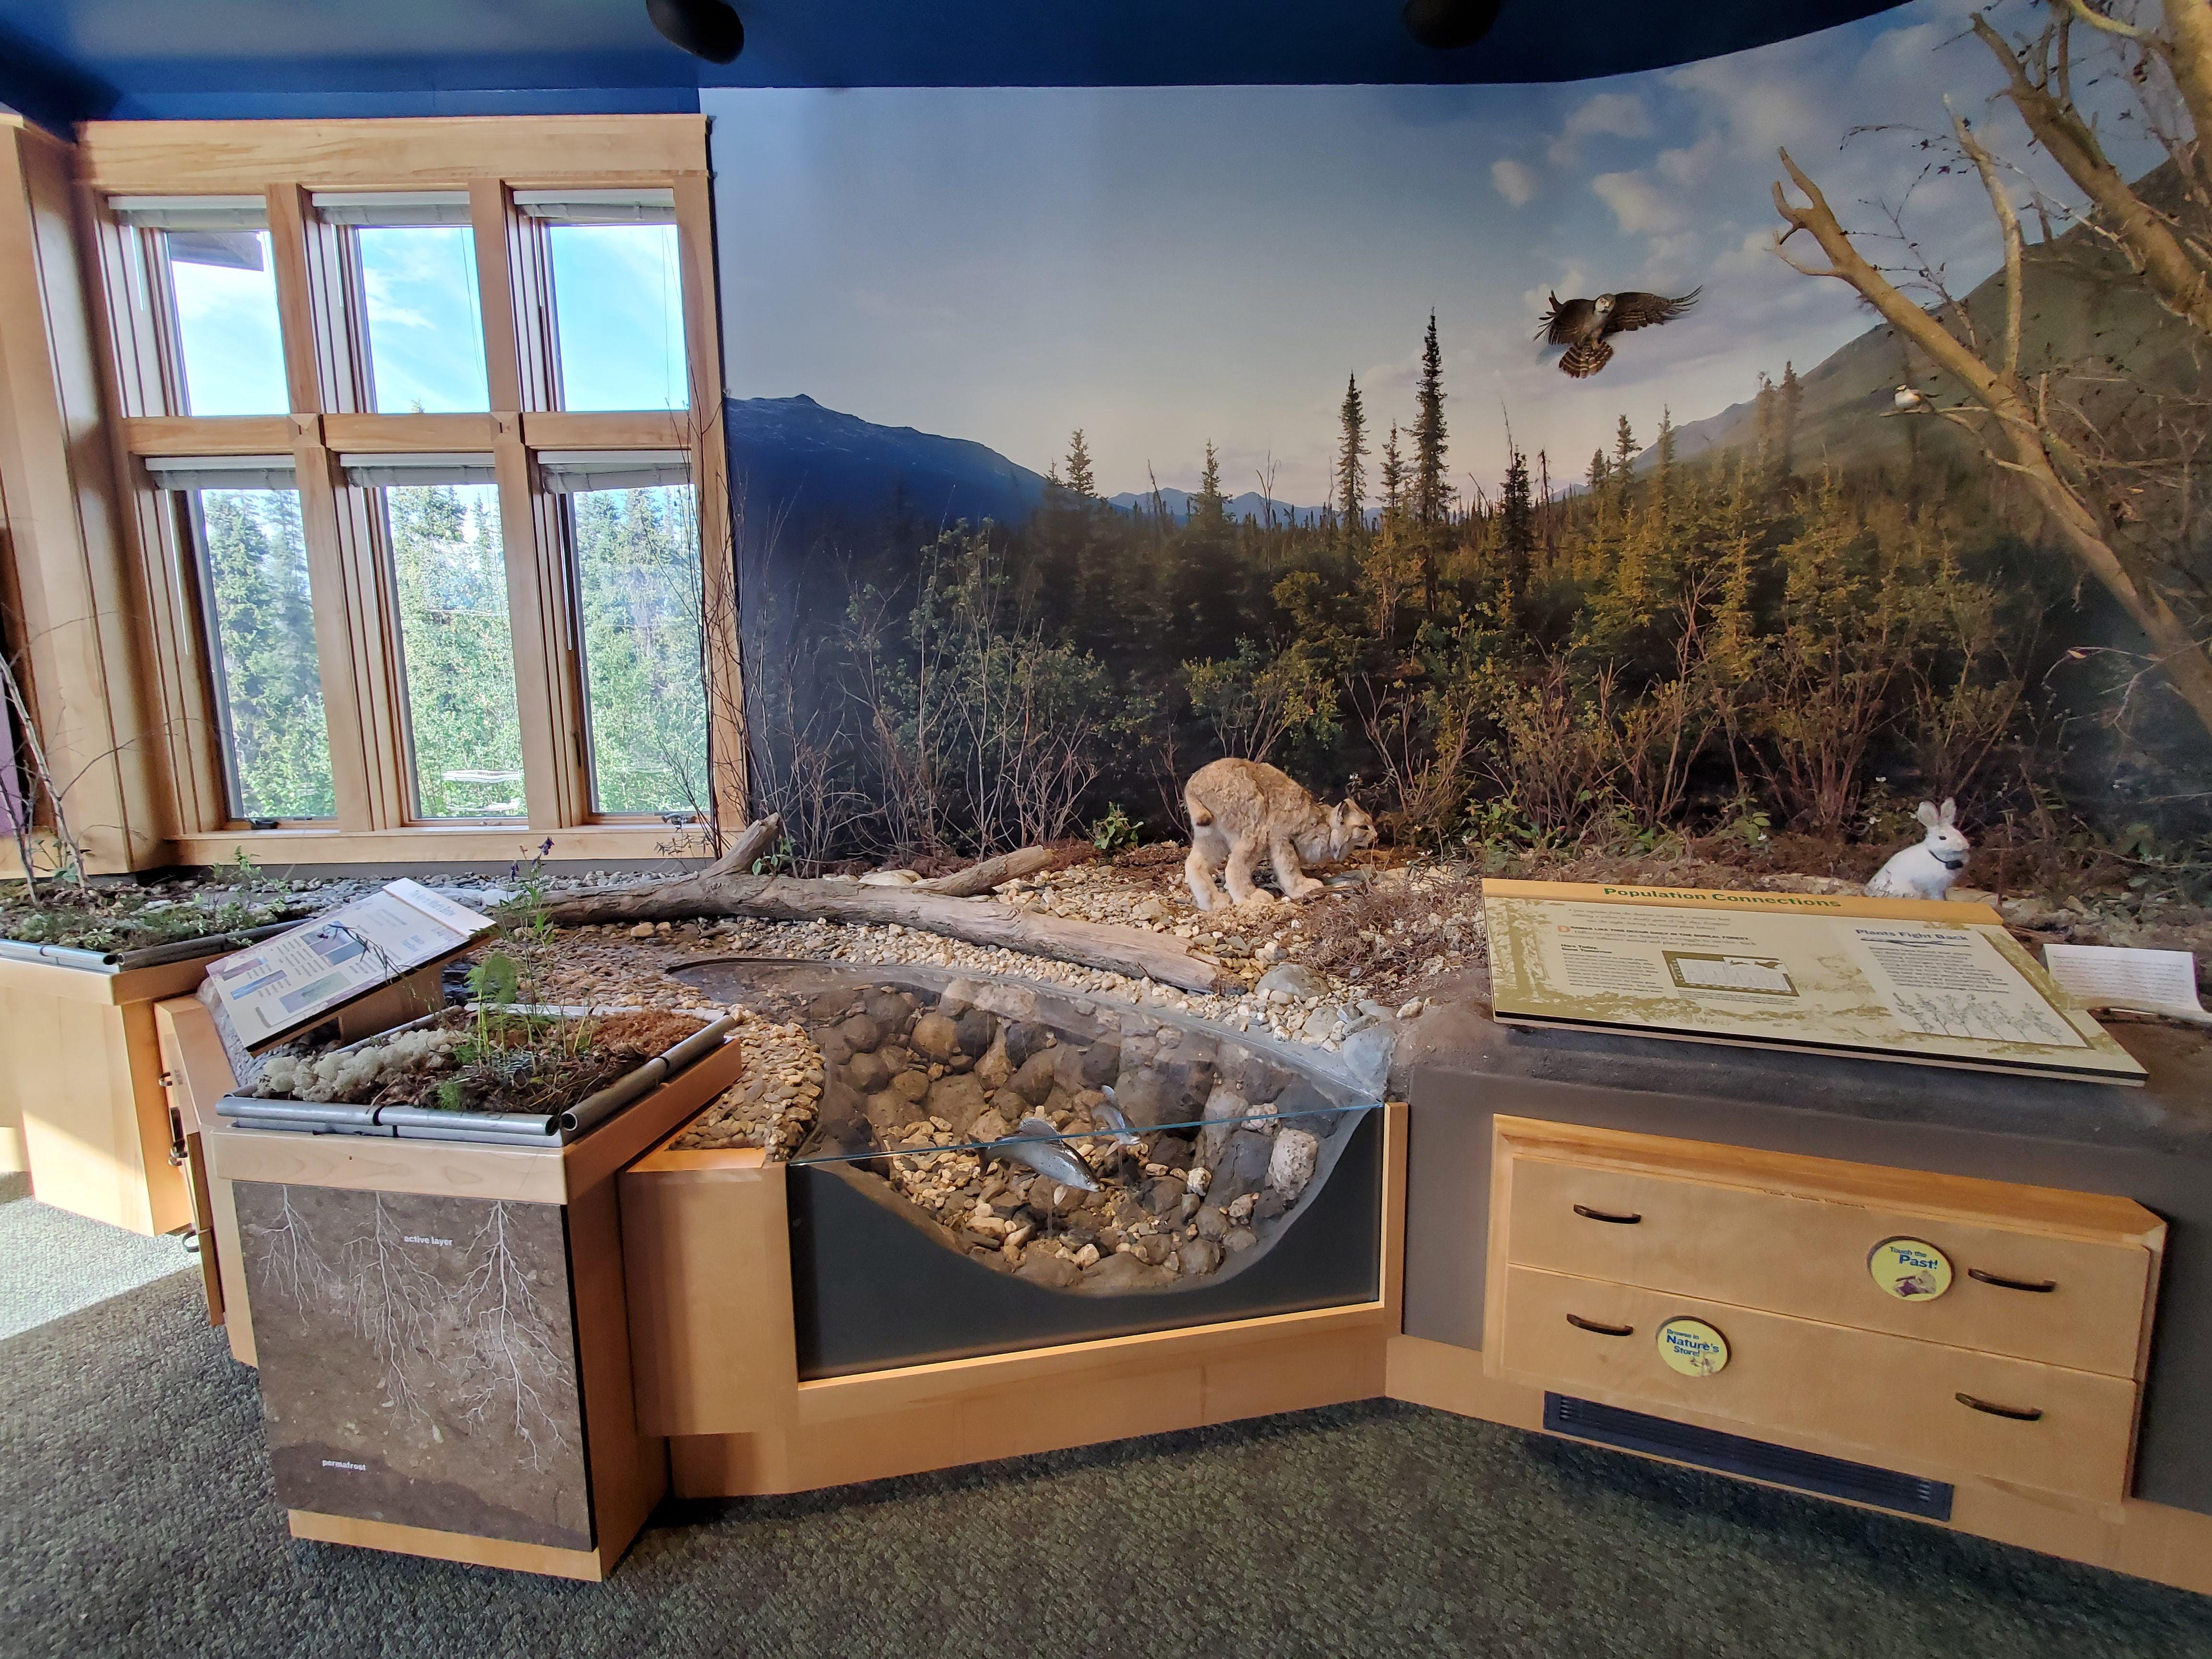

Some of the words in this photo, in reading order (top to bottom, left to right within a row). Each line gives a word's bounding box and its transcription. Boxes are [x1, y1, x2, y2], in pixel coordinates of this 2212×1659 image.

[1604, 888, 1706, 900] Population
[1712, 893, 1841, 907] Connections
[404, 1236, 430, 1244] active
[431, 1236, 453, 1247] layer
[1899, 1254, 1938, 1269] Past!
[1667, 1335, 1719, 1353] Nature's
[1674, 1346, 1700, 1357] Store!
[322, 1460, 366, 1471] permafrost
